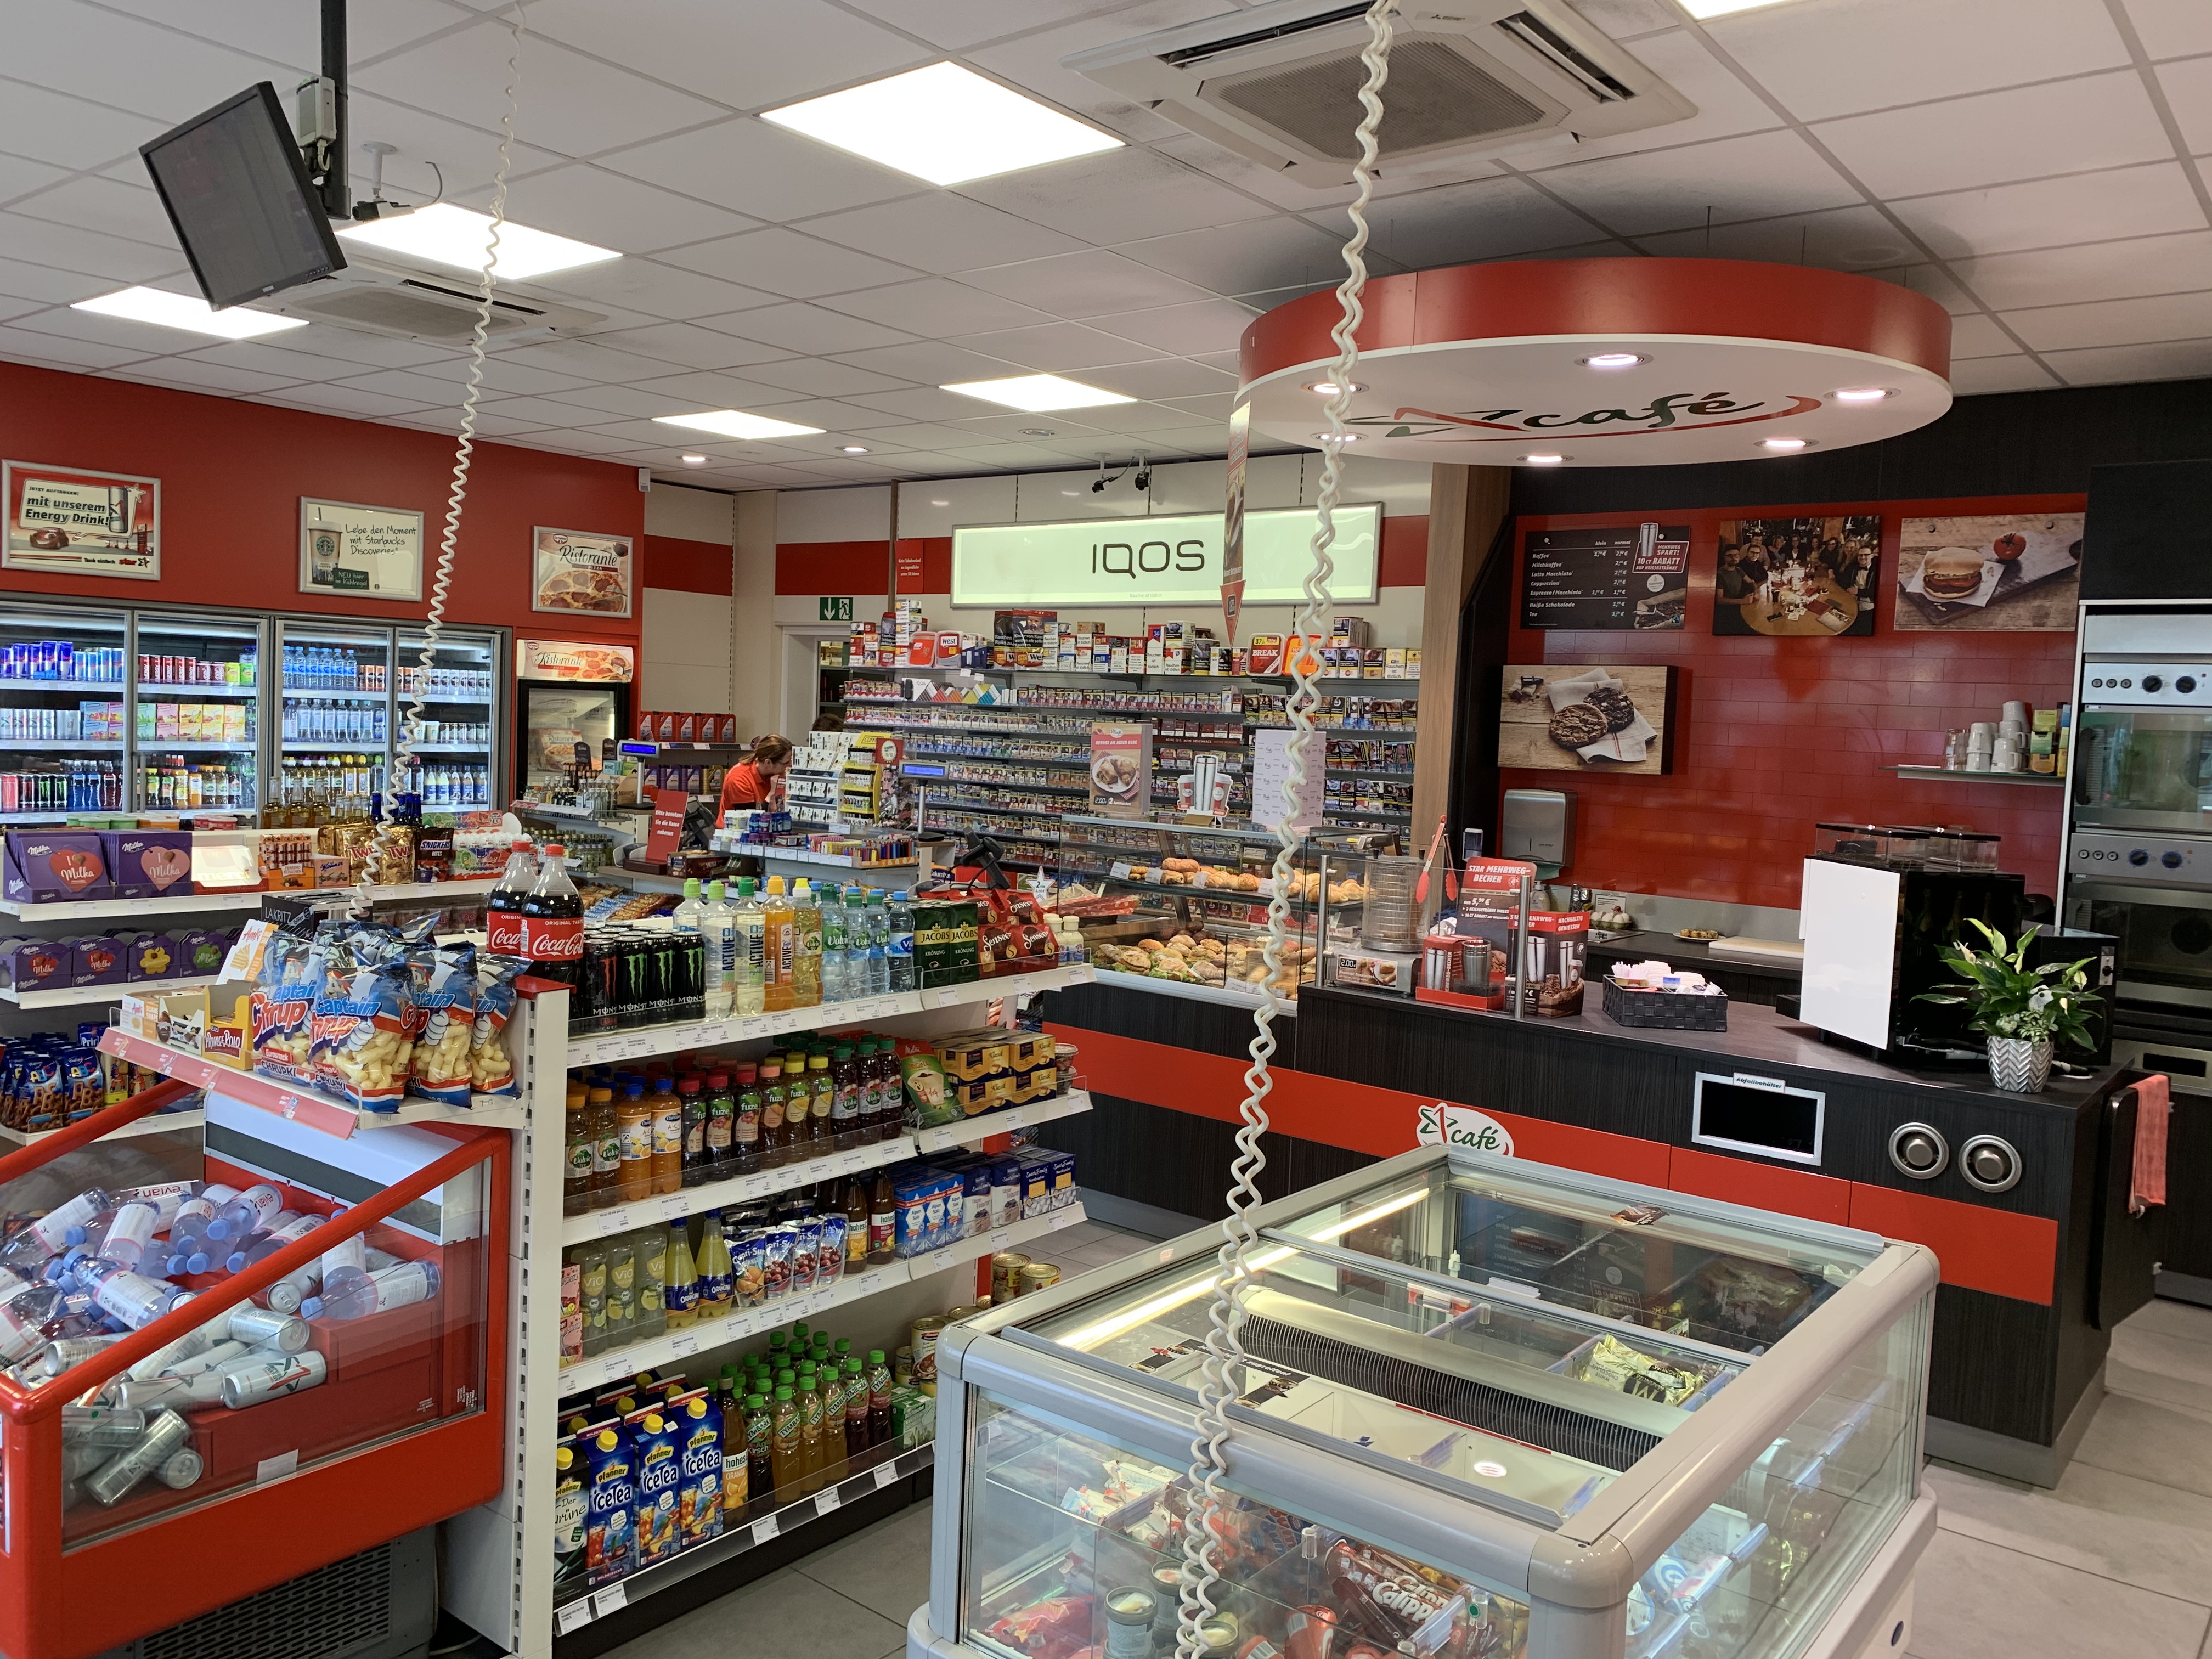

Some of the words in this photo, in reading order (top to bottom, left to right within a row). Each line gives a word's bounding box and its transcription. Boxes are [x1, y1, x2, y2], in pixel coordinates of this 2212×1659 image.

[1523, 392, 1765, 428] café
[27, 496, 49, 506] mit
[54, 499, 105, 512] unserem
[26, 509, 69, 523] Energy
[73, 514, 110, 526] Drink!
[346, 524, 367, 533] Lebe
[370, 525, 384, 534] den
[387, 526, 417, 535] Moment
[350, 535, 362, 544] mit
[365, 535, 405, 545] Starbucks
[560, 545, 617, 567] Ristorante
[1092, 540, 1205, 579] IQOS
[534, 652, 584, 666] Ristorante
[1252, 649, 1278, 657] BREAK
[665, 810, 684, 819] benutzen
[28, 845, 50, 855] Milka
[122, 840, 144, 853] Milka
[421, 839, 451, 850] SNICKERS
[61, 866, 94, 879] Milka
[149, 865, 180, 878] Milka
[1468, 865, 1485, 873] STAR
[1486, 865, 1531, 874] MEHRWEG-
[1473, 874, 1502, 883] BECHER
[265, 907, 292, 923] LAKRITZ
[1558, 916, 1583, 924] NACHHALTIG
[1557, 924, 1581, 932] GENIESSEN
[921, 932, 950, 943] JACOBS
[951, 929, 978, 941] JACOBS
[1023, 931, 1049, 950] Senseo
[80, 941, 97, 951] Milka
[983, 932, 1012, 952] Senseo
[722, 935, 735, 971] ACTIVE
[749, 933, 764, 968] ACTIVE
[782, 945, 792, 970] ACTIVE
[33, 966, 54, 974] Milka
[91, 960, 111, 969] Milka
[75, 974, 96, 984] Milka
[205, 1031, 224, 1049] PRINCE
[224, 1029, 240, 1048] POLO
[266, 1048, 289, 1062] Eurosnack
[261, 1060, 297, 1077] CHRUPKI
[818, 1084, 833, 1092] fuze
[1736, 1077, 1782, 1088] Abfallbehälter
[769, 1094, 783, 1102] fuze
[1451, 1126, 1501, 1150] café
[603, 1149, 620, 1158] Volvic
[573, 1156, 591, 1165] Volvic
[143, 1185, 181, 1198] evian
[256, 1193, 274, 1209] evian
[881, 1215, 895, 1223] hohes
[849, 1223, 865, 1231] hohes
[614, 1268, 633, 1279] ViO
[583, 1276, 603, 1287] ViO
[1592, 1363, 1619, 1381] CHOCOLATE
[1595, 1372, 1610, 1383] WHITE
[1655, 1364, 1684, 1380] MAGNUM
[1636, 1374, 1665, 1391] MAGNUM
[690, 1434, 716, 1448] pfanner
[646, 1448, 673, 1464] pfanner
[726, 1455, 746, 1468] hohes
[598, 1467, 627, 1482] pfanner
[726, 1470, 746, 1480] ORANGE
